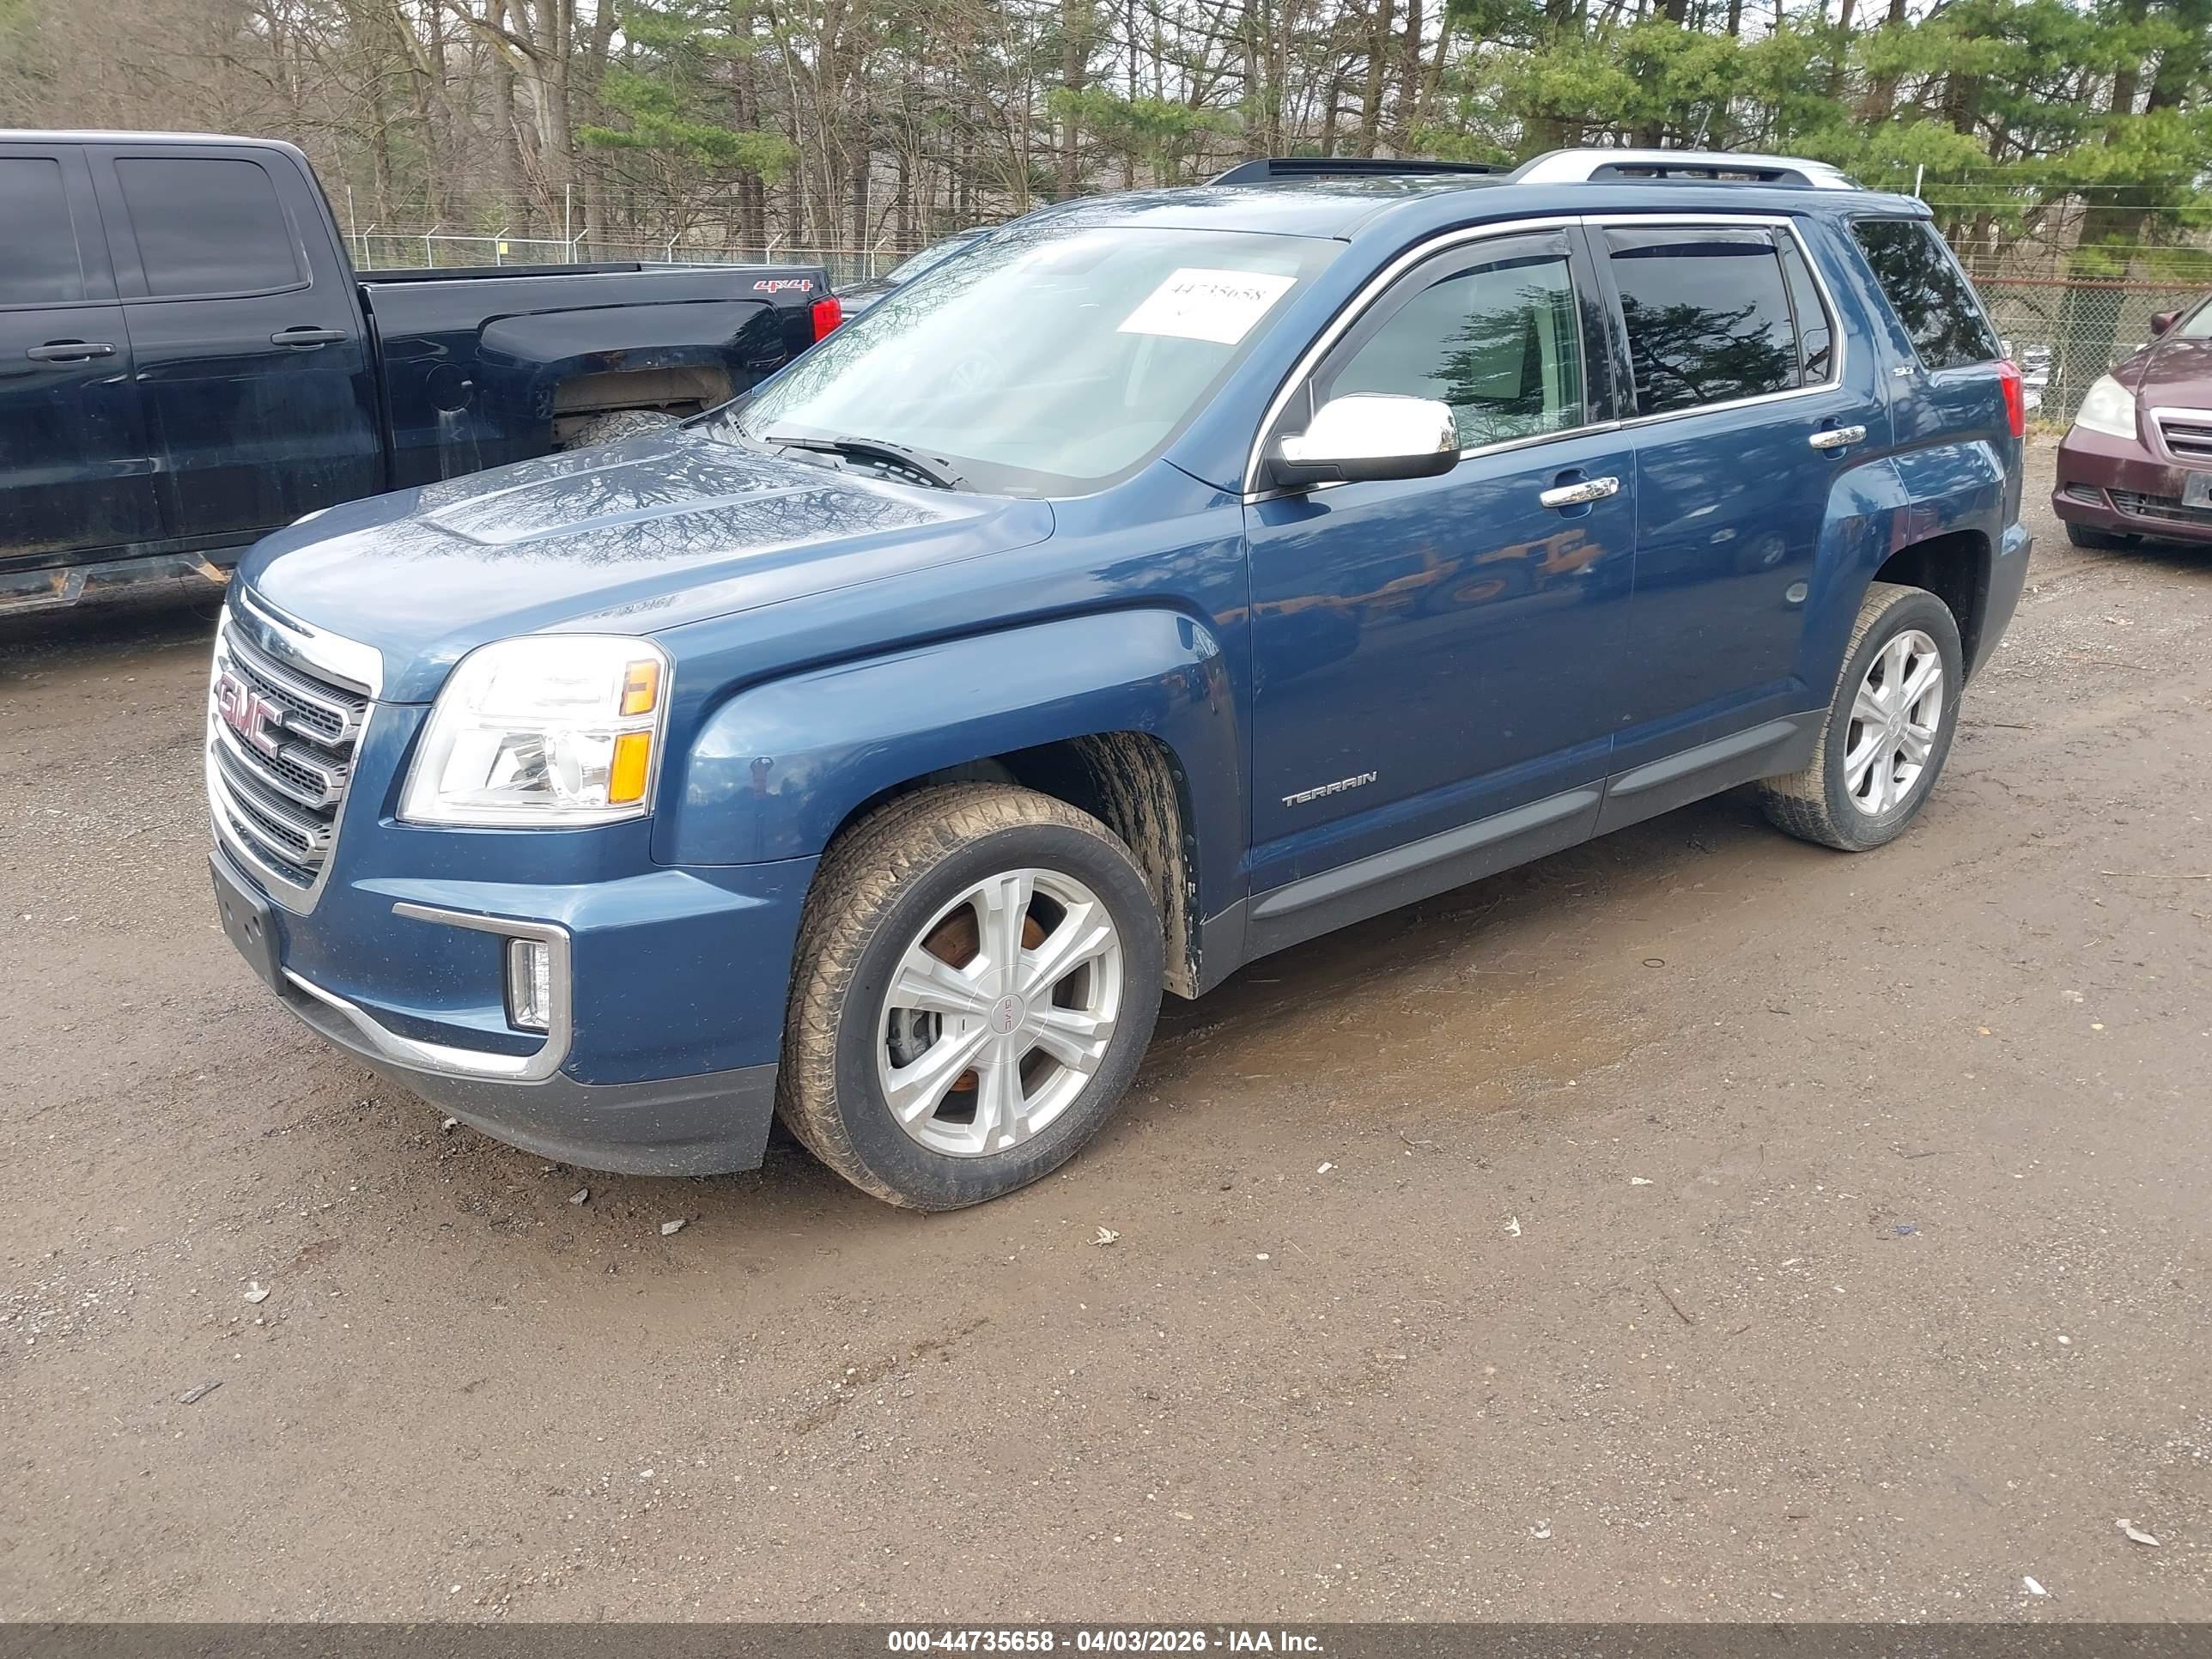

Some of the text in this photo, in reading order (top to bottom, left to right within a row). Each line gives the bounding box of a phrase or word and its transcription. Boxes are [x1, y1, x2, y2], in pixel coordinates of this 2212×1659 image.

[217, 671, 283, 761] GMC
[1281, 770, 1377, 807] TERRAIN
[1004, 998, 1013, 1031] GMC
